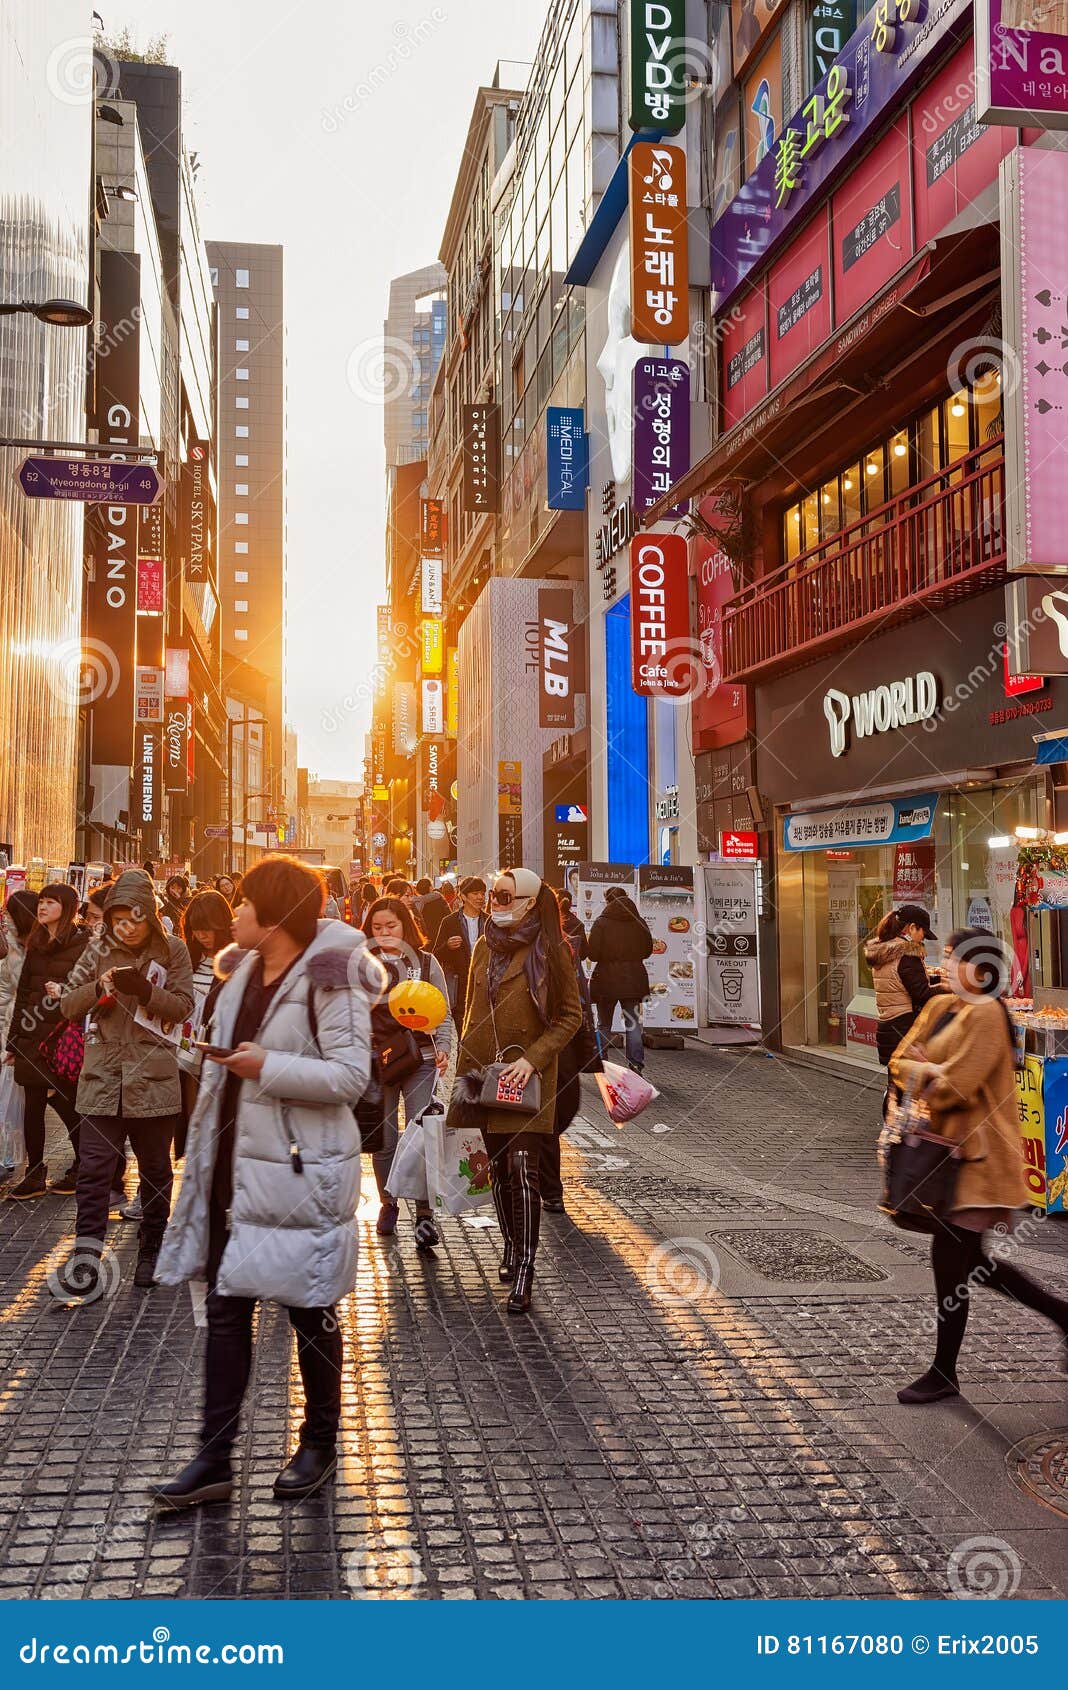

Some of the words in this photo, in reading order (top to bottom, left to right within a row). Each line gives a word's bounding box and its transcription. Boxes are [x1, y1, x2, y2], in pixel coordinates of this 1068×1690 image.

[645, 4, 674, 119] DVD방
[642, 191, 679, 207] 스타몰
[643, 212, 679, 325] 노래방
[26, 473, 39, 482] 52
[68, 463, 111, 479] 명동8길
[560, 426, 573, 499] MEDIHEAL
[50, 478, 107, 491] Myeongdong
[109, 482, 129, 491] 8-gil
[139, 480, 151, 490] 48
[193, 465, 202, 497] HOTEL
[190, 501, 203, 574] SKYPARK
[638, 545, 666, 656] COFFEE
[543, 617, 569, 698] MLB
[639, 664, 668, 678] Cafe
[640, 679, 656, 687] John
[852, 671, 937, 738] WORLD
[143, 734, 153, 762] LINE
[429, 745, 438, 776] SAVOY
[142, 764, 153, 822] FRIENDS
[716, 959, 732, 967] TAKE
